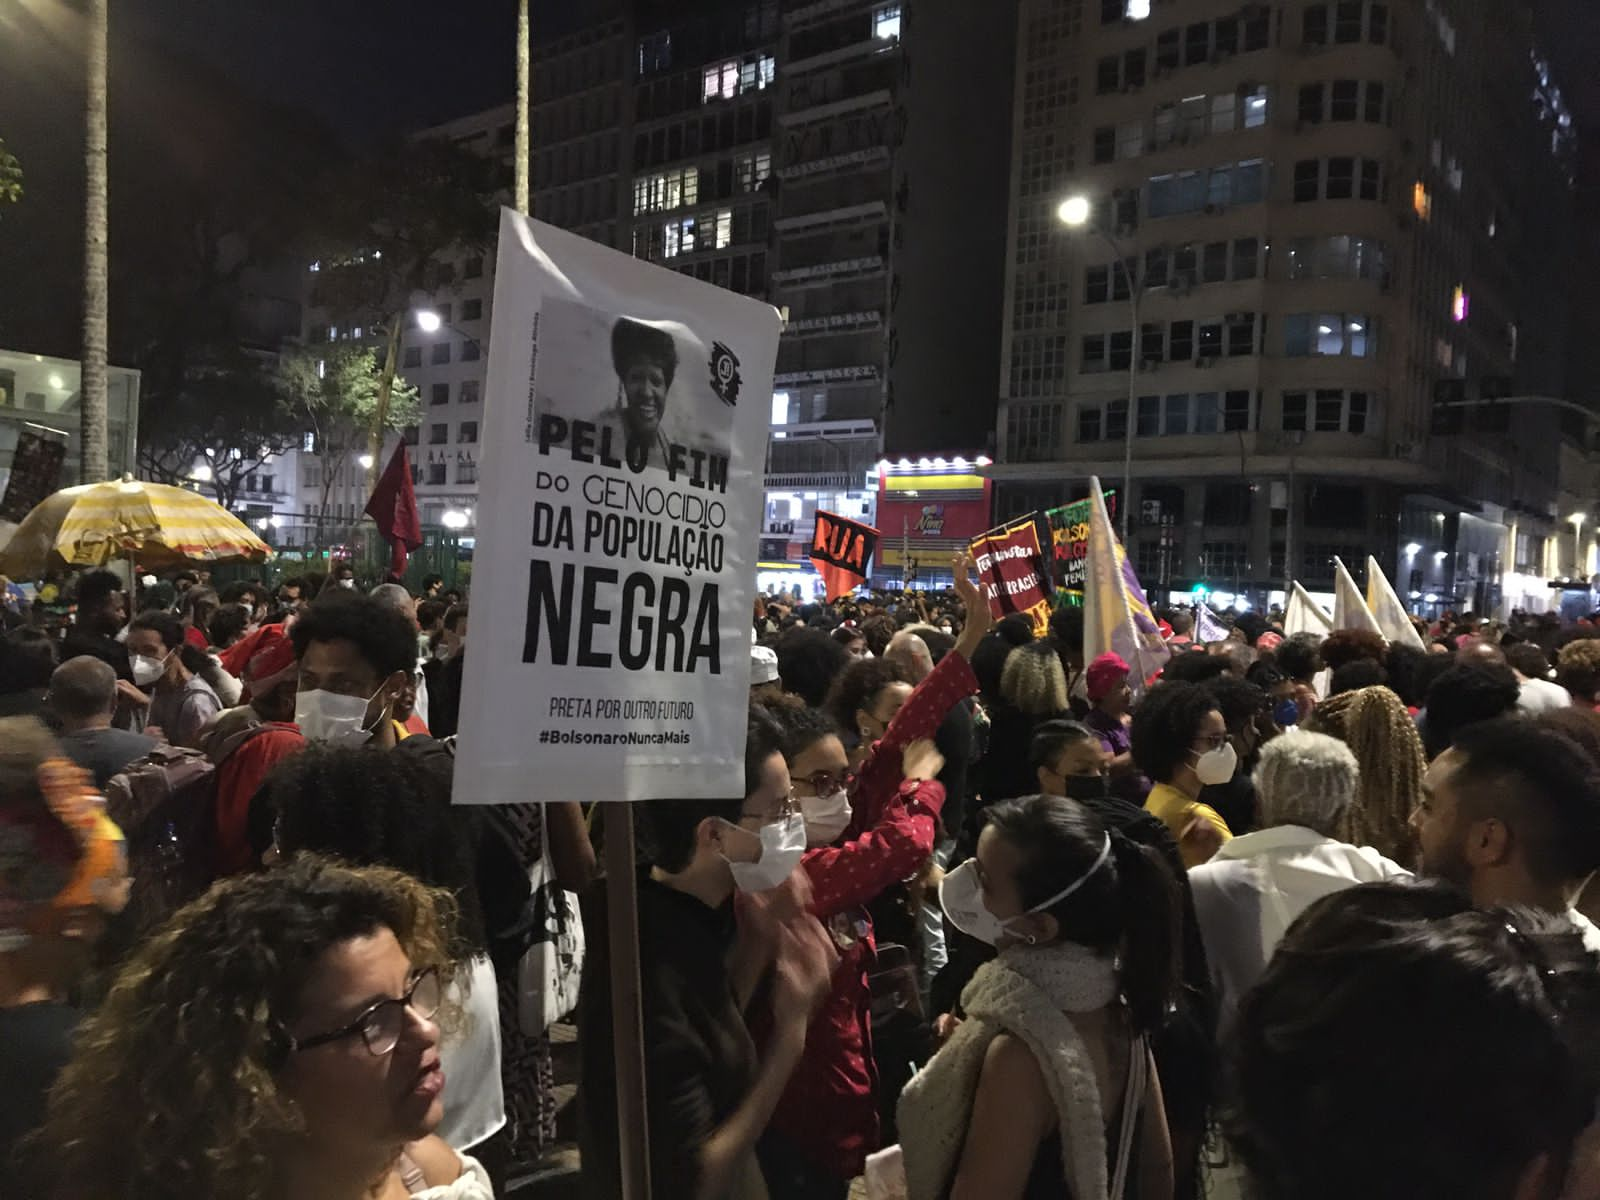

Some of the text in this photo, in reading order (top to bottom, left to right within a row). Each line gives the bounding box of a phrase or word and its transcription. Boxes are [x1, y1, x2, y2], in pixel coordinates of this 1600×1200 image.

[539, 413, 729, 494] PELO FIM
[536, 471, 726, 529] DO GENOCIDIO
[532, 501, 725, 576] DA POPULAÇÃO
[814, 517, 865, 568] RUA
[521, 559, 721, 675] NEGRA
[539, 729, 691, 745] #BolsonaroNuncaMais
[550, 697, 694, 720] PRETA POR OUTRO FUTURO
